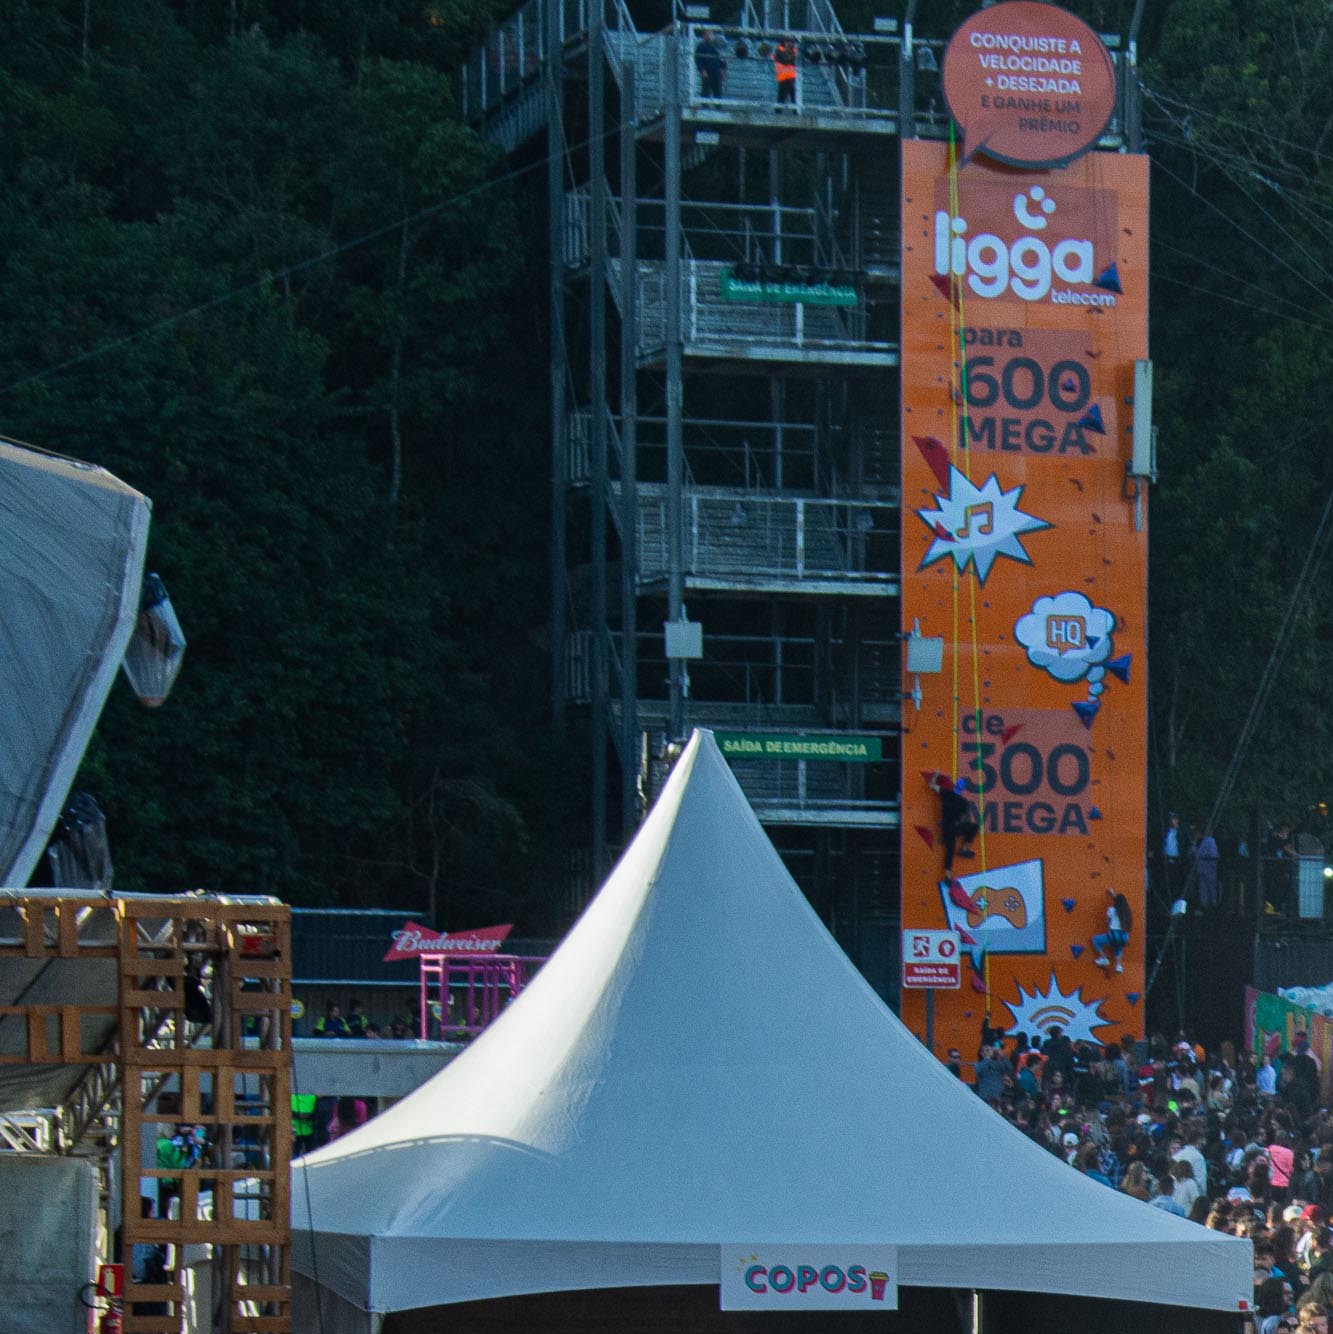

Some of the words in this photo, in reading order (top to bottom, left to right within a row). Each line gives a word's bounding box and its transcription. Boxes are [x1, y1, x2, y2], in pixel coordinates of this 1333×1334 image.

[969, 32, 1066, 53] CONQUISTE
[1069, 40, 1081, 54] A
[979, 54, 1081, 75] VELOCIDADE
[997, 75, 1081, 94] DESEJADA
[982, 95, 989, 109] E
[993, 97, 1051, 112] GANHE
[1055, 99, 1081, 113] UM
[1018, 116, 1081, 133] PRÊMIO
[934, 210, 1094, 301] ligga
[1052, 289, 1116, 307] telecom
[960, 327, 1024, 348] para
[959, 356, 1092, 412] 600
[959, 415, 1089, 455] MEGA
[1051, 622, 1082, 646] HQ
[962, 713, 1005, 736] de
[723, 738, 763, 752] SAÍDA
[766, 741, 782, 753] DE
[784, 741, 868, 756] EMERGÊNCIA
[960, 742, 1090, 796] 300
[390, 929, 503, 952] Budweiser
[744, 1264, 868, 1294] COPOS
